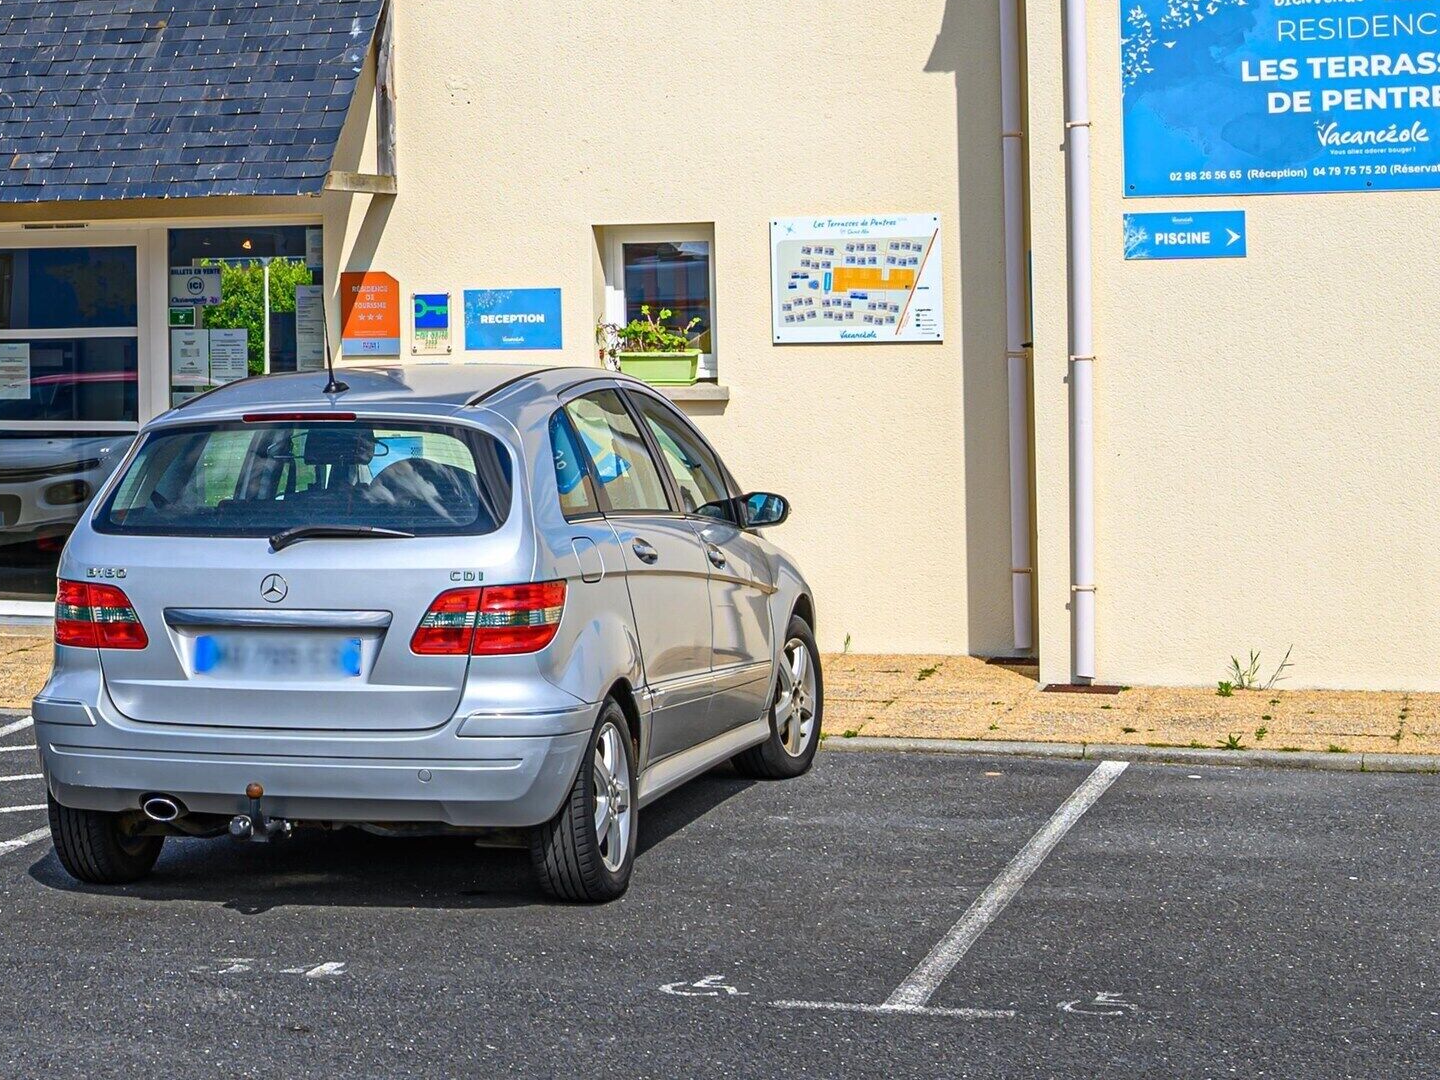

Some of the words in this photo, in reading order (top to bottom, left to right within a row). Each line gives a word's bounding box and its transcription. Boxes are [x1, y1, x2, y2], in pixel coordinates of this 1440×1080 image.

[1277, 12, 1438, 42] RESIDENC
[1241, 58, 1299, 82] LES
[1306, 52, 1440, 80] TERRAS
[1267, 91, 1312, 114] DE
[1317, 120, 1429, 146] Vacancéole
[1169, 171, 1182, 181] 02
[1184, 171, 1197, 181] 98
[1199, 170, 1212, 180] 26
[1214, 170, 1227, 180] 56
[1229, 169, 1242, 179] 65
[1246, 167, 1308, 180] (Réception)
[1313, 167, 1326, 176] 04
[1328, 166, 1341, 176] 79
[1344, 165, 1357, 175] 75
[1360, 165, 1372, 175] 75
[1374, 164, 1387, 175] 20
[813, 220, 824, 228] Les
[827, 219, 859, 228] Terrasses
[1155, 231, 1211, 245] PISCINE
[189, 282, 202, 290] ICI
[480, 313, 545, 324] RECEPTION
[450, 570, 484, 581] CDI
